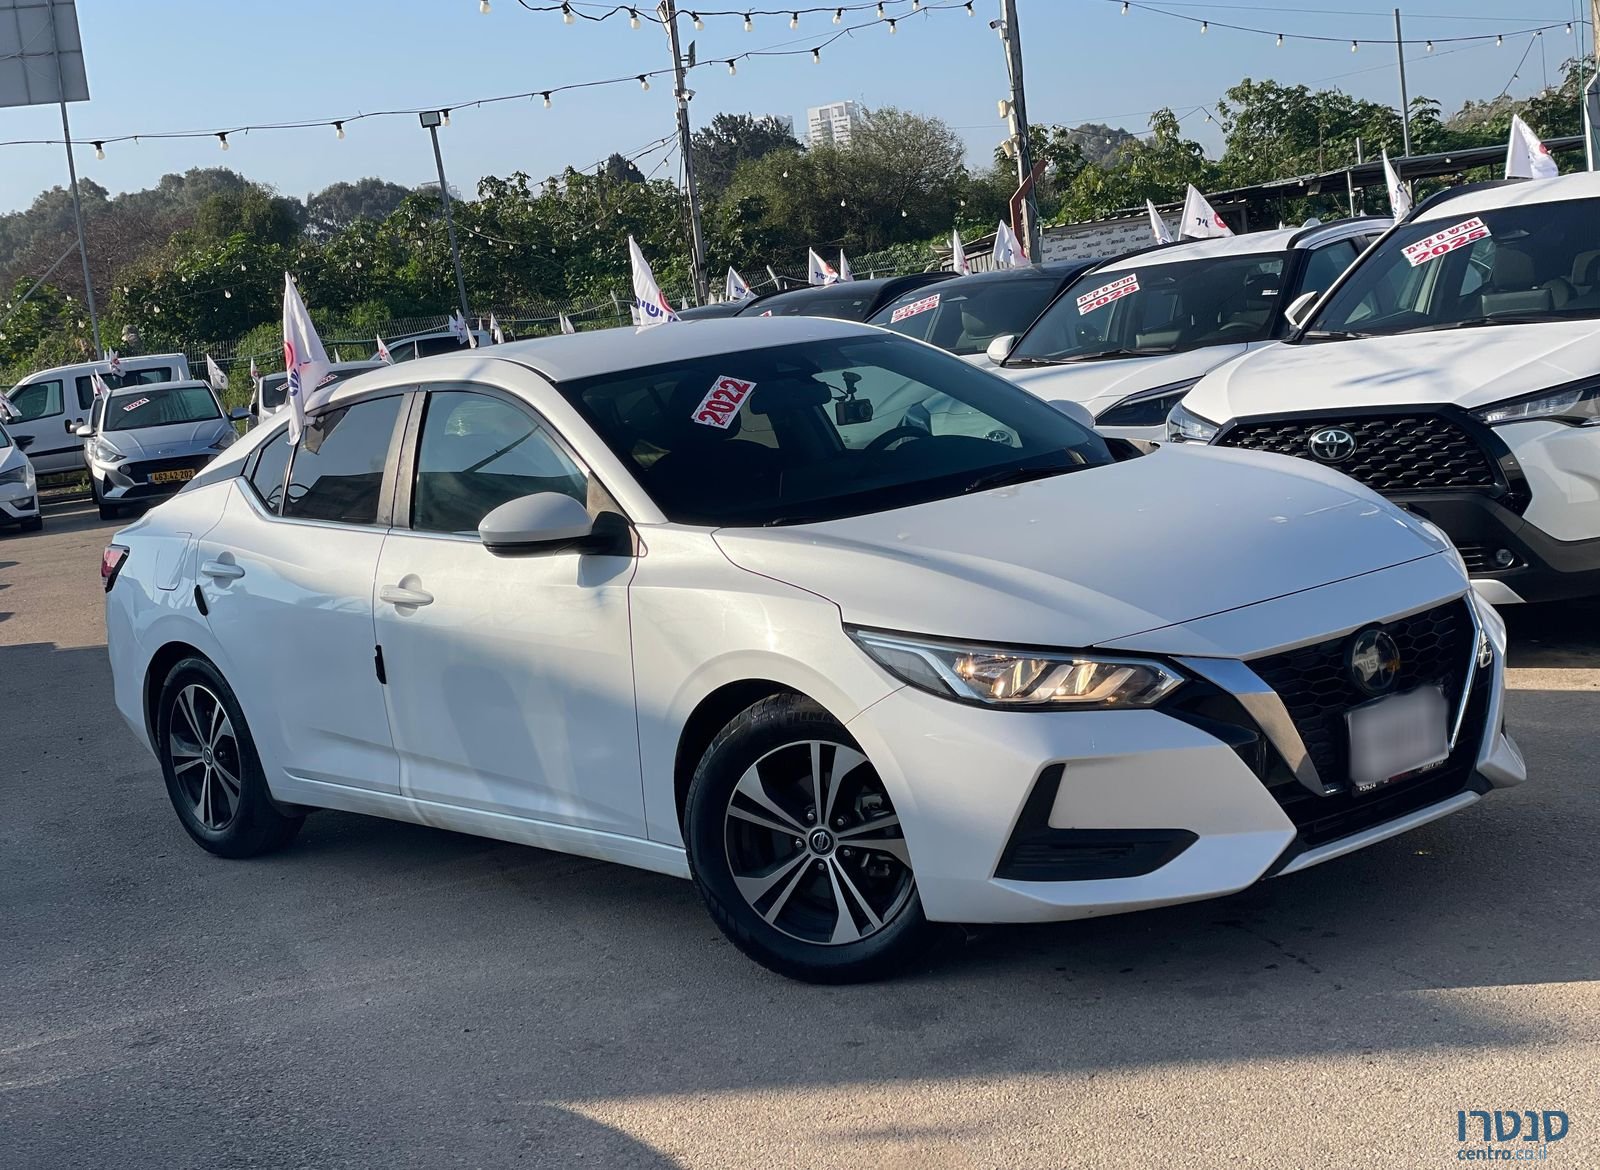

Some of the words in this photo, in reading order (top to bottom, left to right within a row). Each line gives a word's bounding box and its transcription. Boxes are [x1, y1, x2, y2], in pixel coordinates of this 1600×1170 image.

[1448, 220, 1479, 235] חדש
[1413, 229, 1488, 265] 2025
[1082, 284, 1138, 313] 2025
[697, 379, 751, 426] 2022
